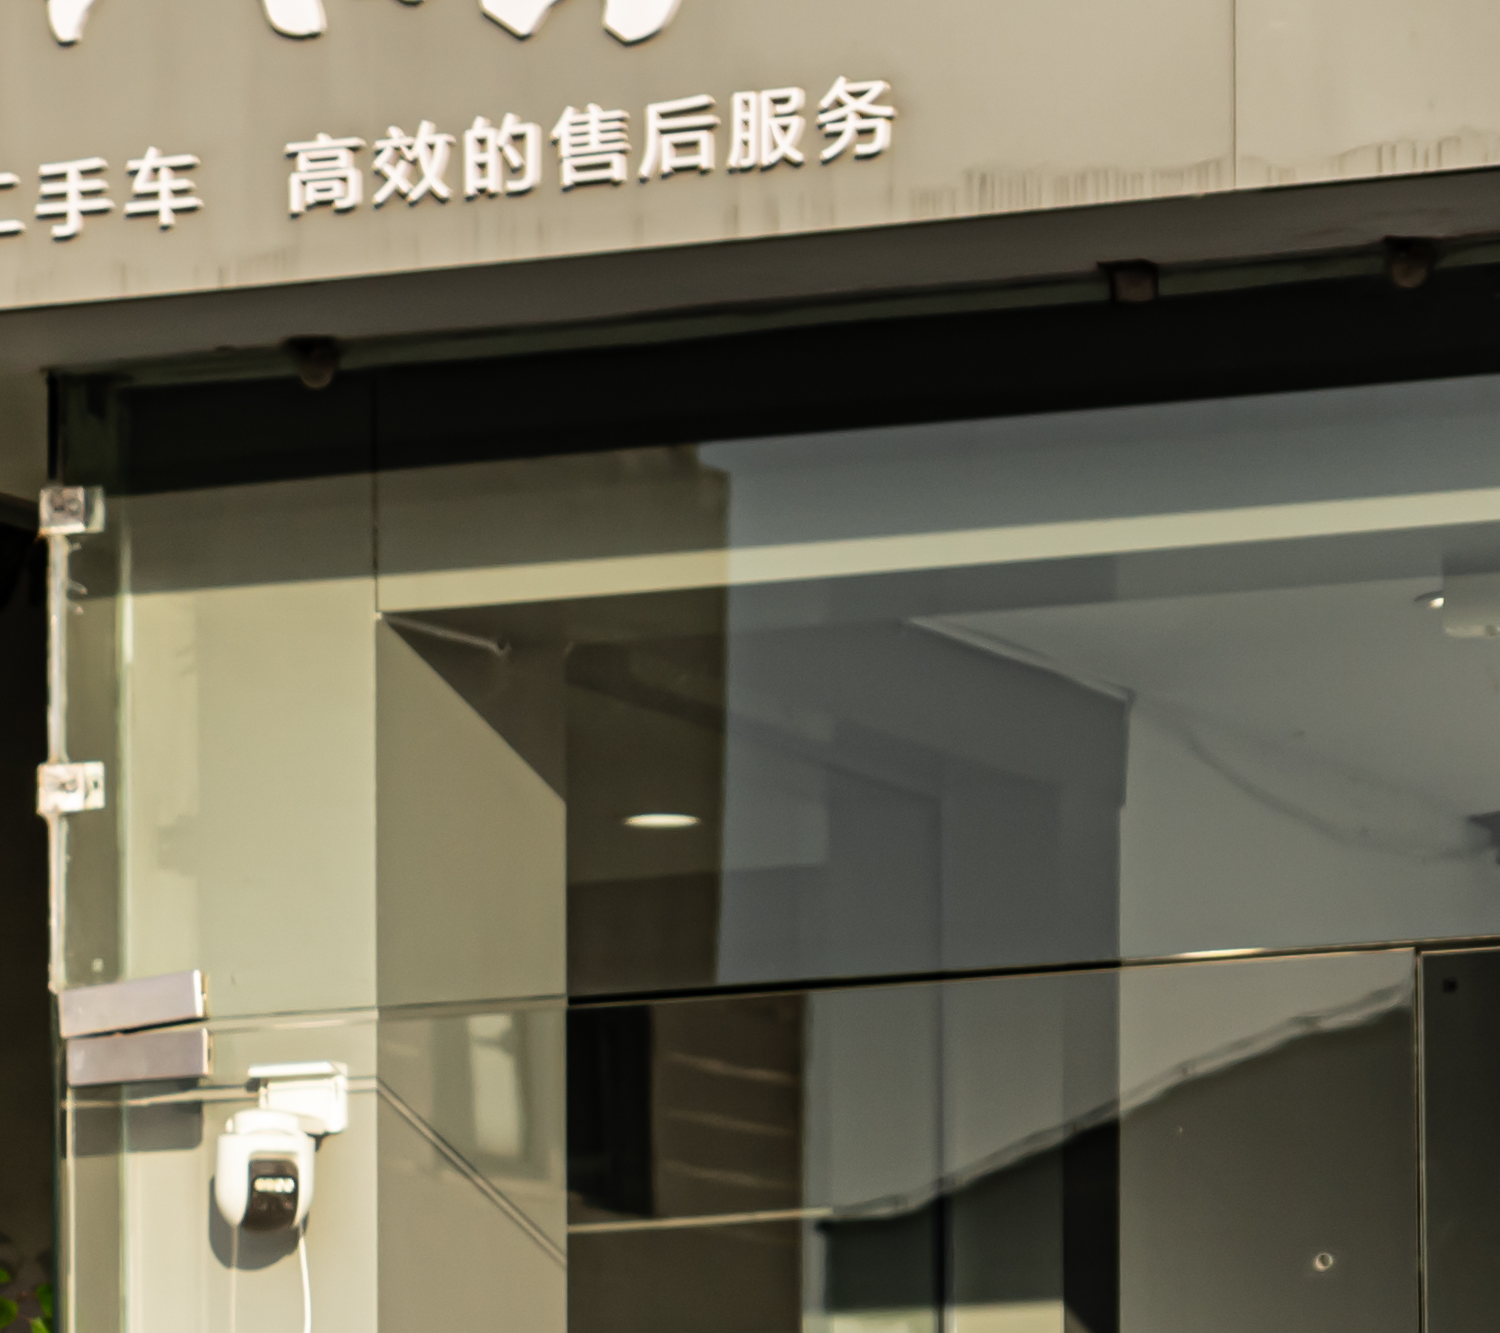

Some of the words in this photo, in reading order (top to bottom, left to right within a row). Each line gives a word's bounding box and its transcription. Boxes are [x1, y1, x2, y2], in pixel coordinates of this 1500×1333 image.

[284, 75, 897, 218] 高效的售后服务
